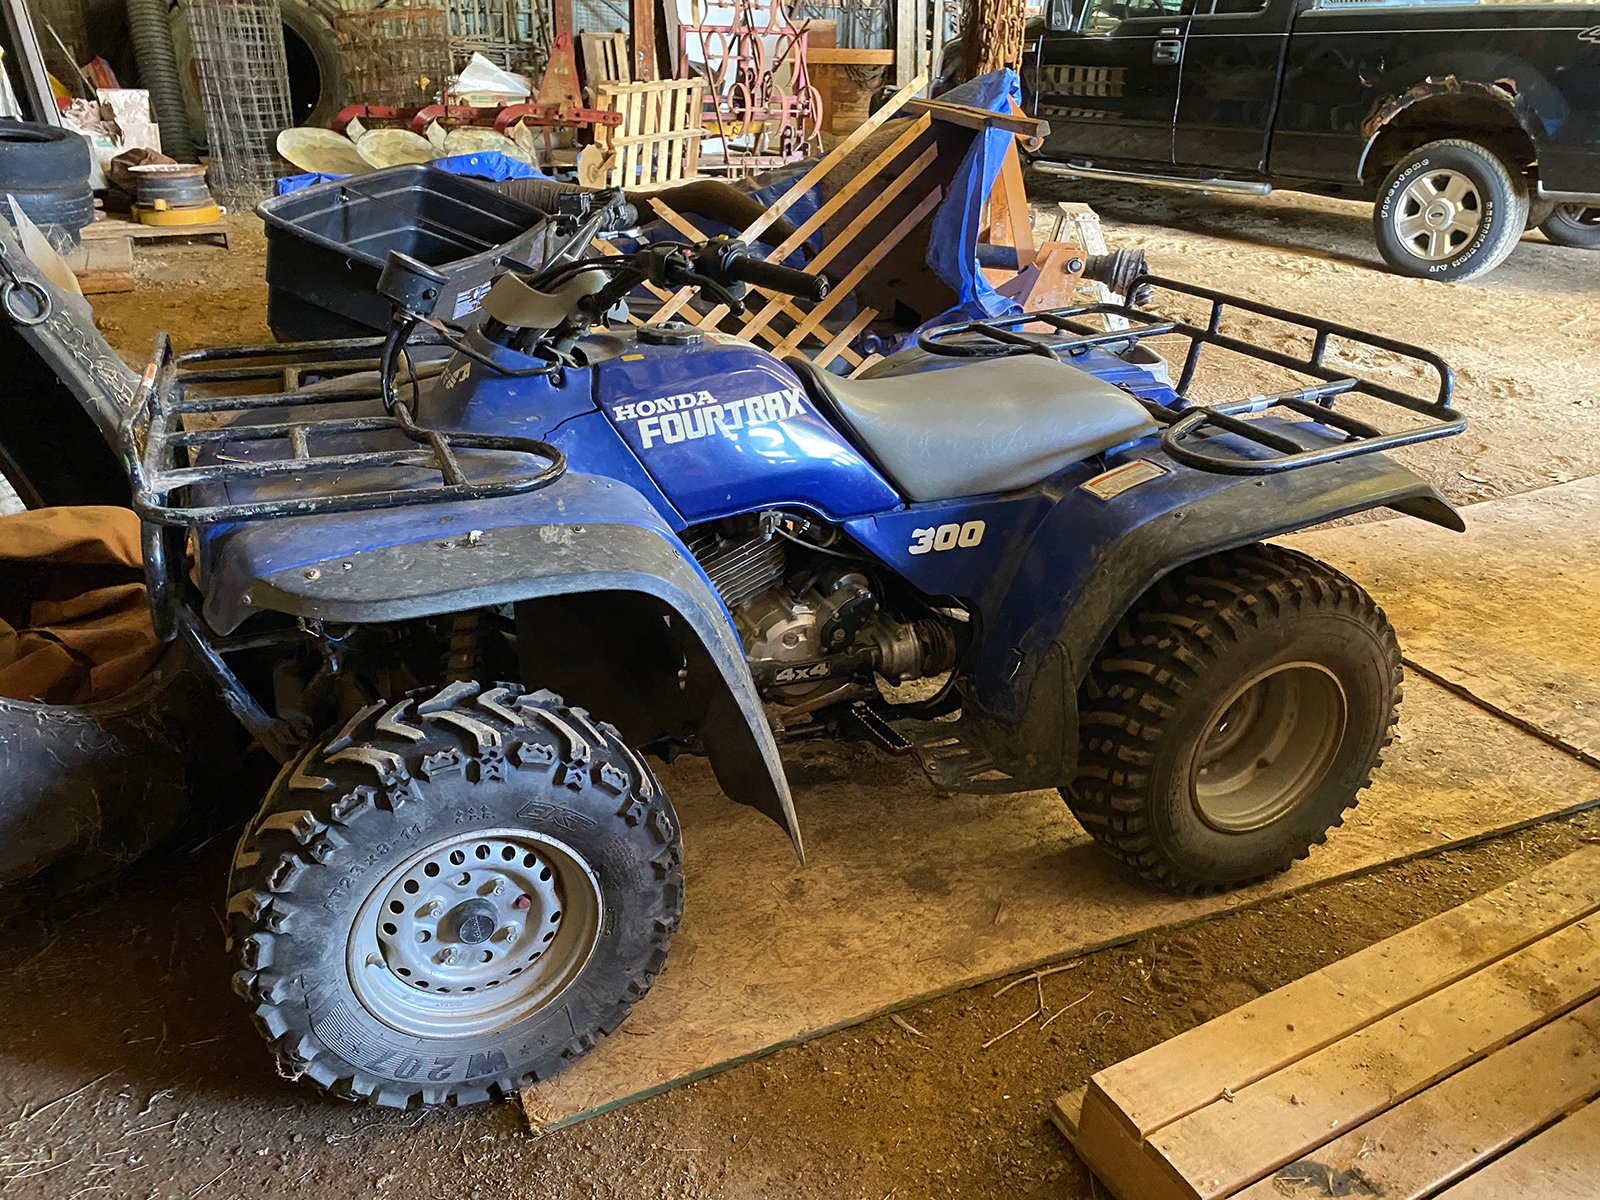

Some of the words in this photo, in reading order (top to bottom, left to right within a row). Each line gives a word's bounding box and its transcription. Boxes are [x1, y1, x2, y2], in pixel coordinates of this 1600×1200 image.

[612, 390, 718, 422] HONDA
[637, 386, 807, 450] FOURTRAX
[908, 519, 987, 556] 300
[776, 661, 829, 682] 4x4
